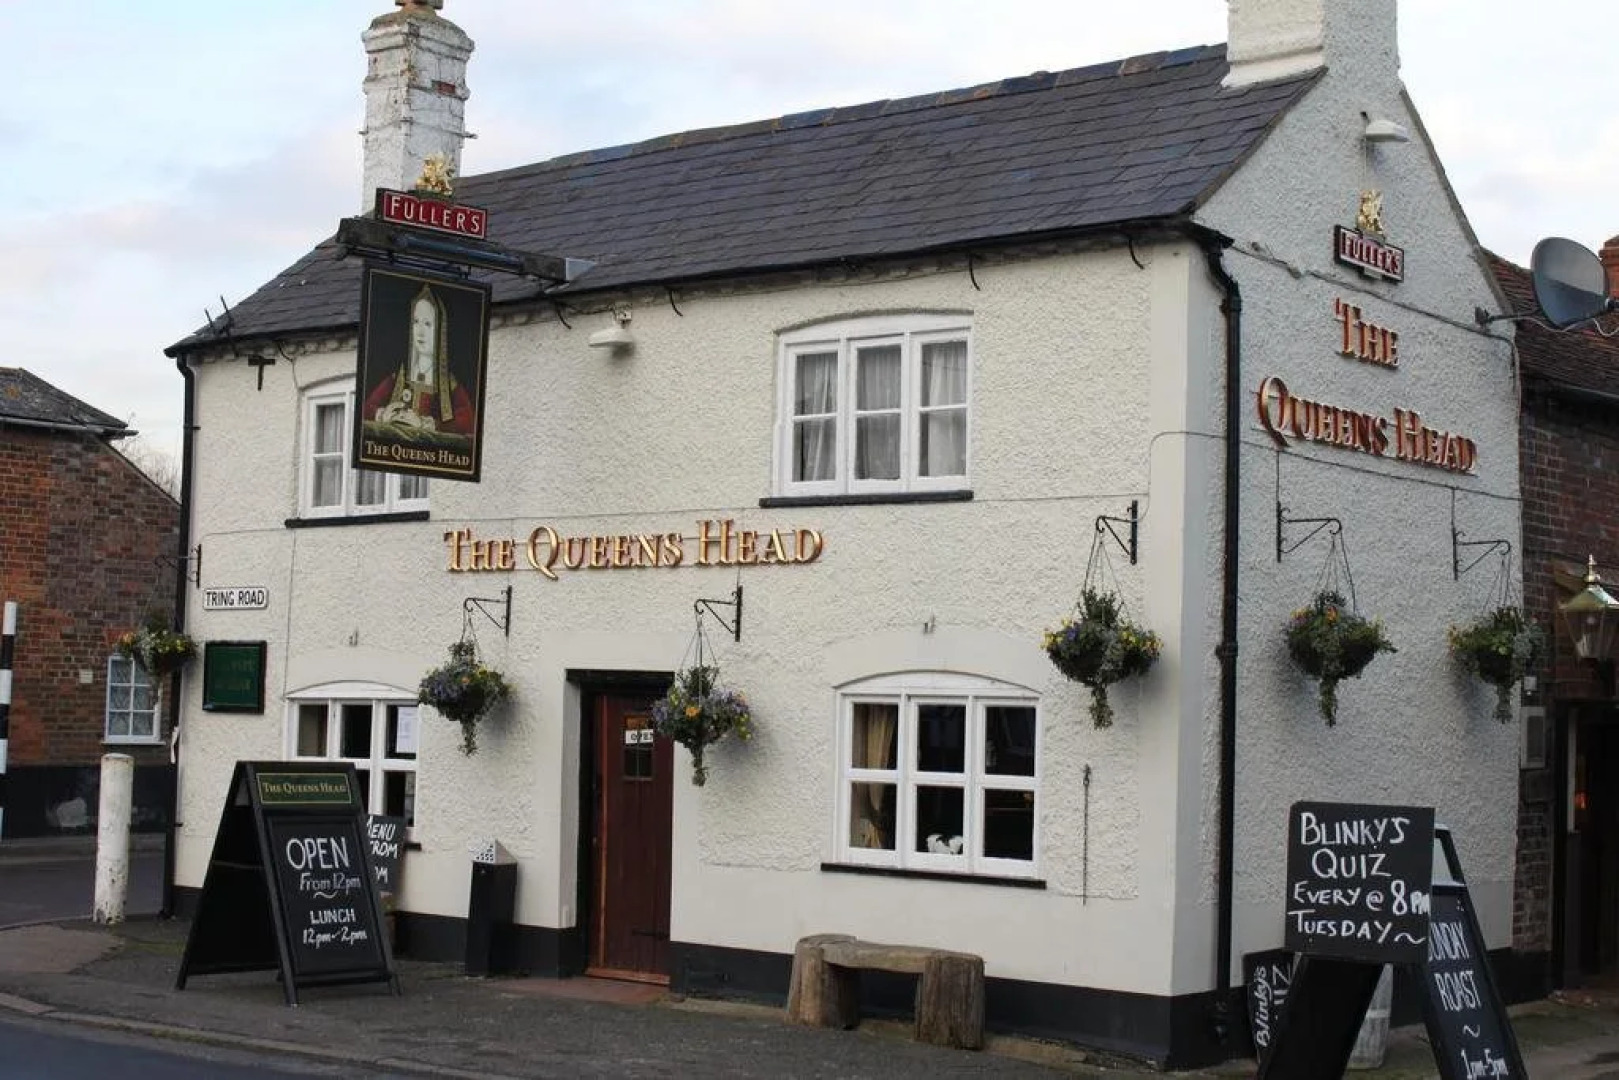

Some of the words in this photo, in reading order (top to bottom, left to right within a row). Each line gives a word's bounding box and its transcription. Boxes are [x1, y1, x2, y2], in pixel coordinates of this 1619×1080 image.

[391, 196, 480, 234] FULLER'S
[1345, 233, 1401, 275] FULLER'S
[1334, 297, 1399, 369] THE
[1258, 376, 1389, 456] QUEENS
[1394, 407, 1478, 474] HEAD
[365, 441, 389, 456] THE
[391, 443, 436, 463] QUEENS
[439, 449, 470, 466] HEAD
[444, 527, 516, 572] THE
[527, 525, 684, 581] QUEENS
[696, 518, 824, 566] HEAD
[206, 592, 235, 606] TRING
[238, 590, 265, 605] ROAD
[262, 782, 282, 793] THE
[283, 782, 320, 795] QUEENS
[286, 836, 349, 869] OPEN
[1312, 848, 1392, 879] QUIZ
[300, 872, 333, 891] From
[333, 872, 361, 895] 12pm
[1294, 880, 1361, 906] EVERY
[1366, 890, 1385, 911] @
[310, 908, 356, 924] LUNCH
[1429, 921, 1470, 962] UNDAY
[1434, 970, 1481, 1012] ROAST
